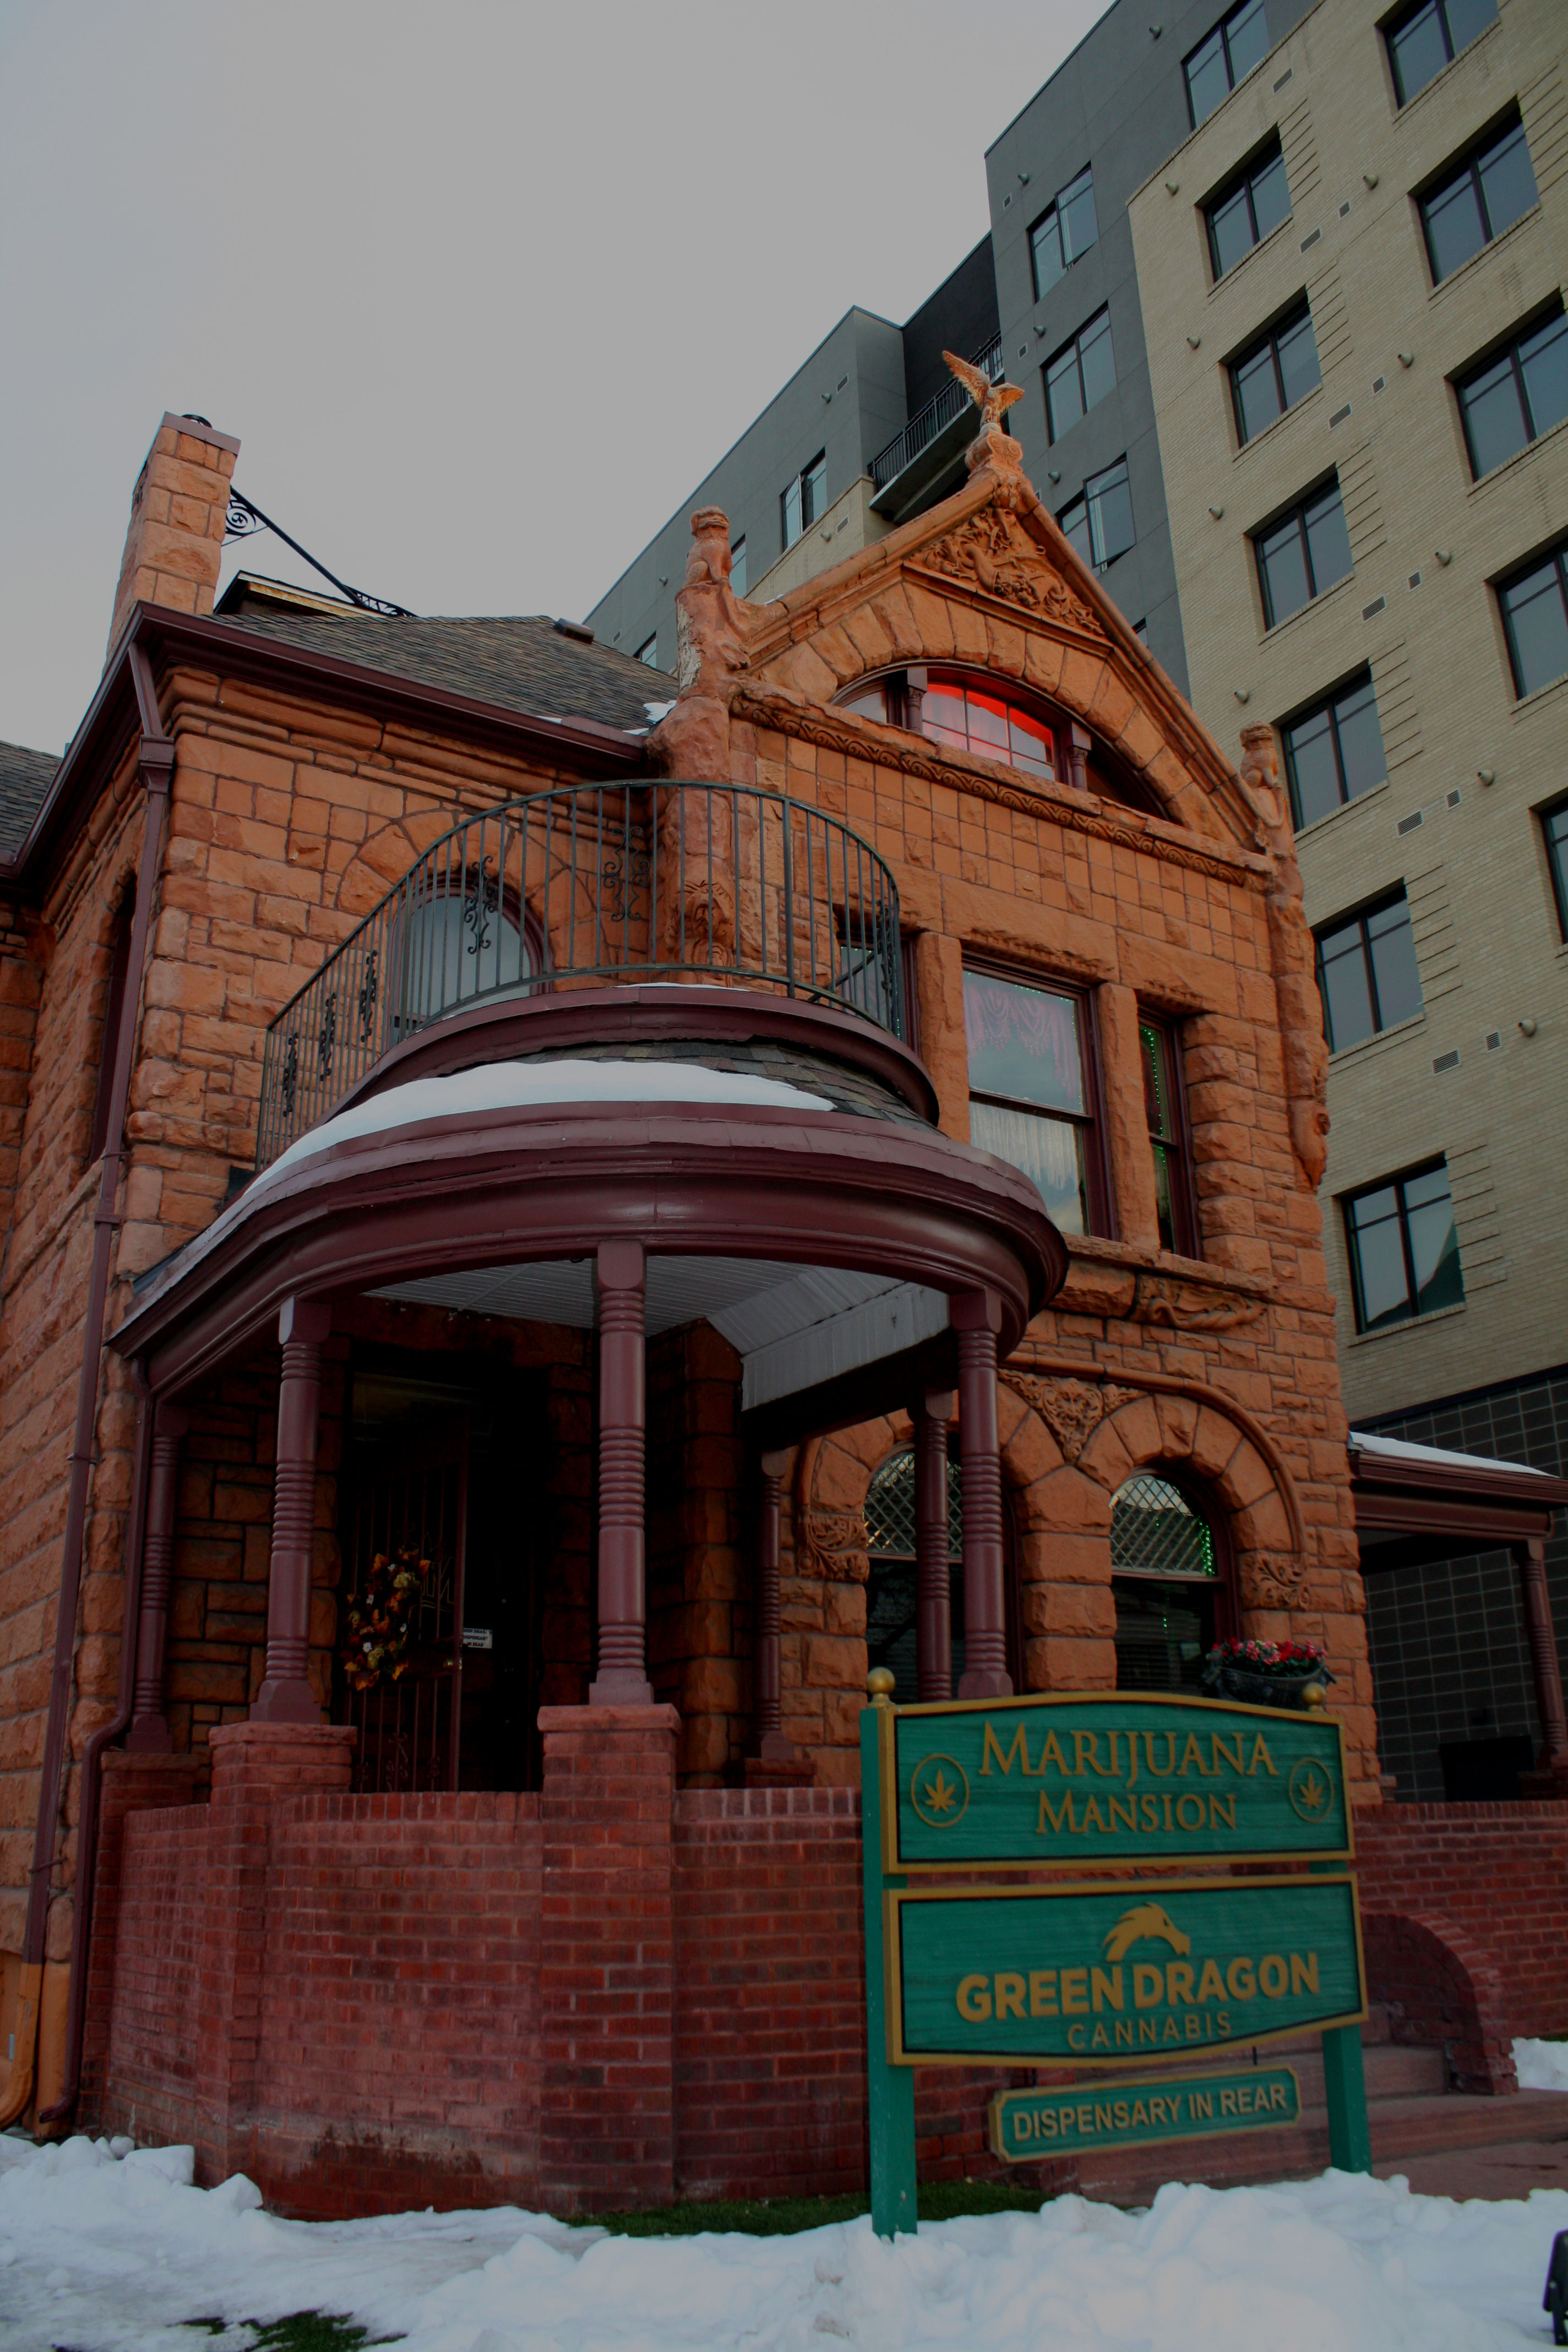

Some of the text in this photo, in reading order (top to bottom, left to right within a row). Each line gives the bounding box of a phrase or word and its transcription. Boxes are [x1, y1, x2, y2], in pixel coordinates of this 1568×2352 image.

[979, 1721, 1280, 1789] MARIJUANA
[1036, 1789, 1237, 1834] MANSION
[956, 1952, 1320, 2023] GREEN DRAGON
[1067, 2011, 1232, 2051] CANNABIS
[1013, 2083, 1289, 2142] DISPENSARY IN REAR
